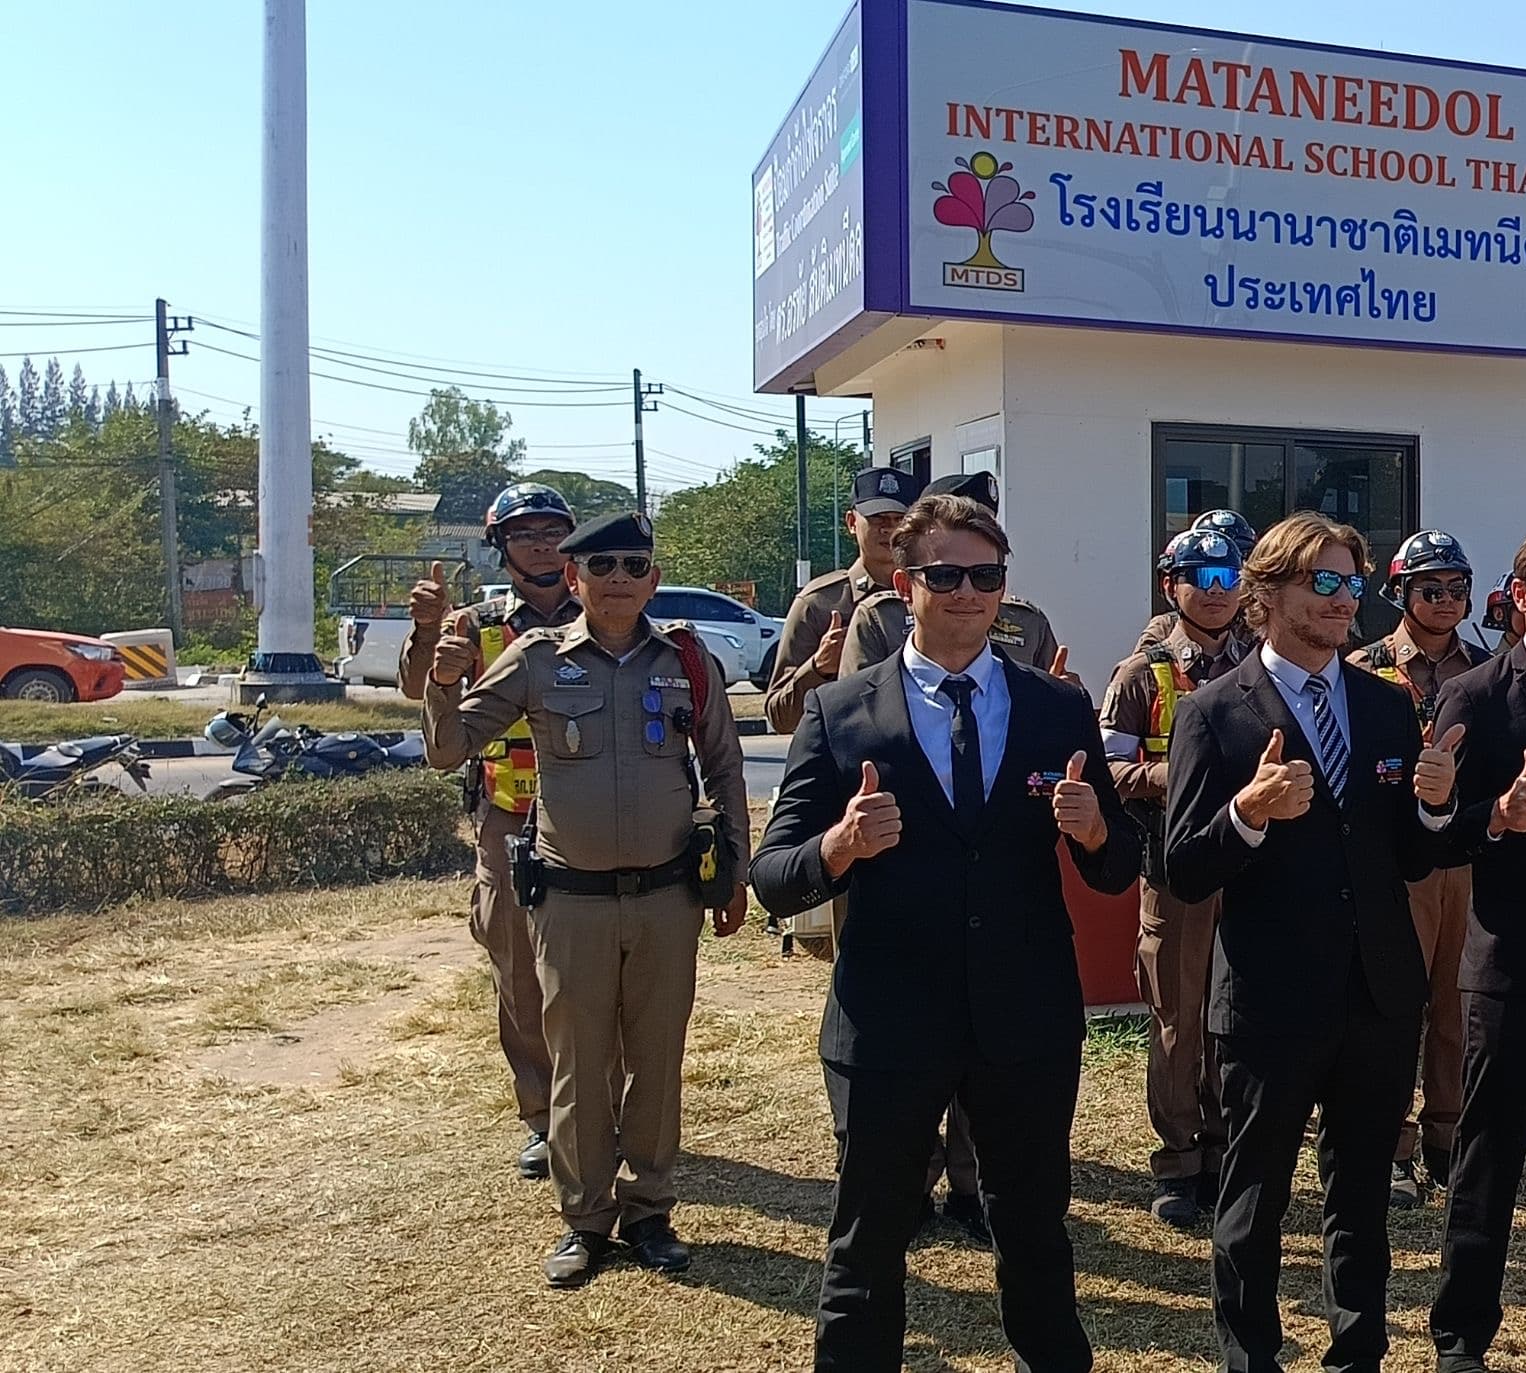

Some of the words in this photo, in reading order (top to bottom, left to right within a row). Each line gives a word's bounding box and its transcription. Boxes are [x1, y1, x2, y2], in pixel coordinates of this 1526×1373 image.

[1119, 48, 1515, 141] MATANEEDOL
[945, 102, 1294, 172] INTERNATIONAL
[1304, 142, 1456, 188] SCHOOL
[951, 267, 1018, 287] MTDS
[1203, 263, 1438, 323] ประเทศไทย
